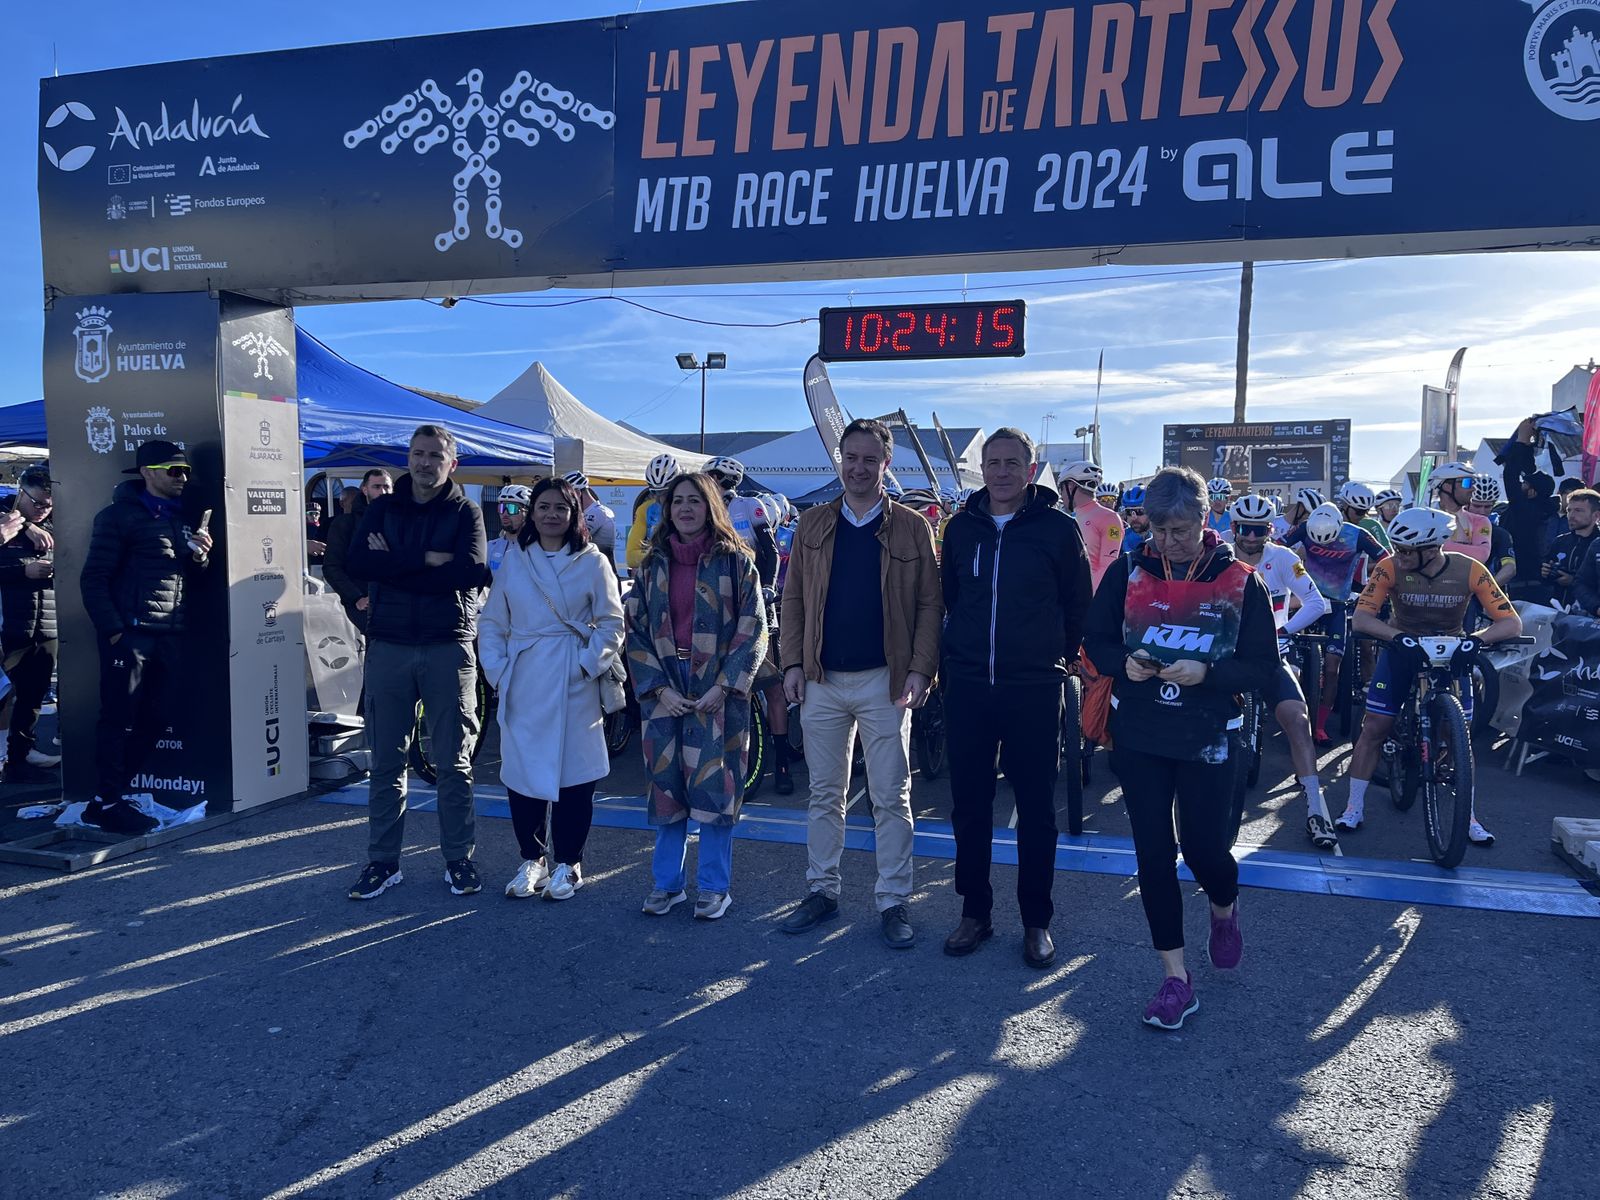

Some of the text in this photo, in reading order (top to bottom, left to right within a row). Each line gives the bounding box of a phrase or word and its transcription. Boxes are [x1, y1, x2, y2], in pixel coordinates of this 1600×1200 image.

[647, 49, 680, 92] LA
[641, 20, 966, 159] LEYENDA
[979, 88, 1017, 134] DE
[107, 93, 271, 150] Andalucía
[218, 156, 237, 164] Junta
[227, 161, 260, 171] Andalucía
[634, 176, 711, 233] MTB
[732, 168, 833, 228] RACE
[854, 157, 1009, 222] HUELVA
[1033, 146, 1149, 213] 2024
[1160, 146, 1178, 161] by
[195, 197, 265, 208] Fondos Europeos
[119, 247, 170, 273] UCI
[174, 262, 228, 270] INTERNATIONALE
[844, 307, 1014, 352] 10:24:15
[117, 340, 186, 353] Ayuntamiento de
[117, 353, 186, 371] HUELVA
[121, 410, 164, 420] Ayuntamiento
[123, 423, 167, 436] Palos de
[124, 439, 135, 451] la
[248, 491, 284, 499] VALVERDE
[1141, 623, 1215, 653] KTM
[1436, 644, 1446, 655] 9
[156, 739, 183, 749] OTOR
[265, 717, 280, 767] UCI
[141, 773, 205, 795] Monday!
